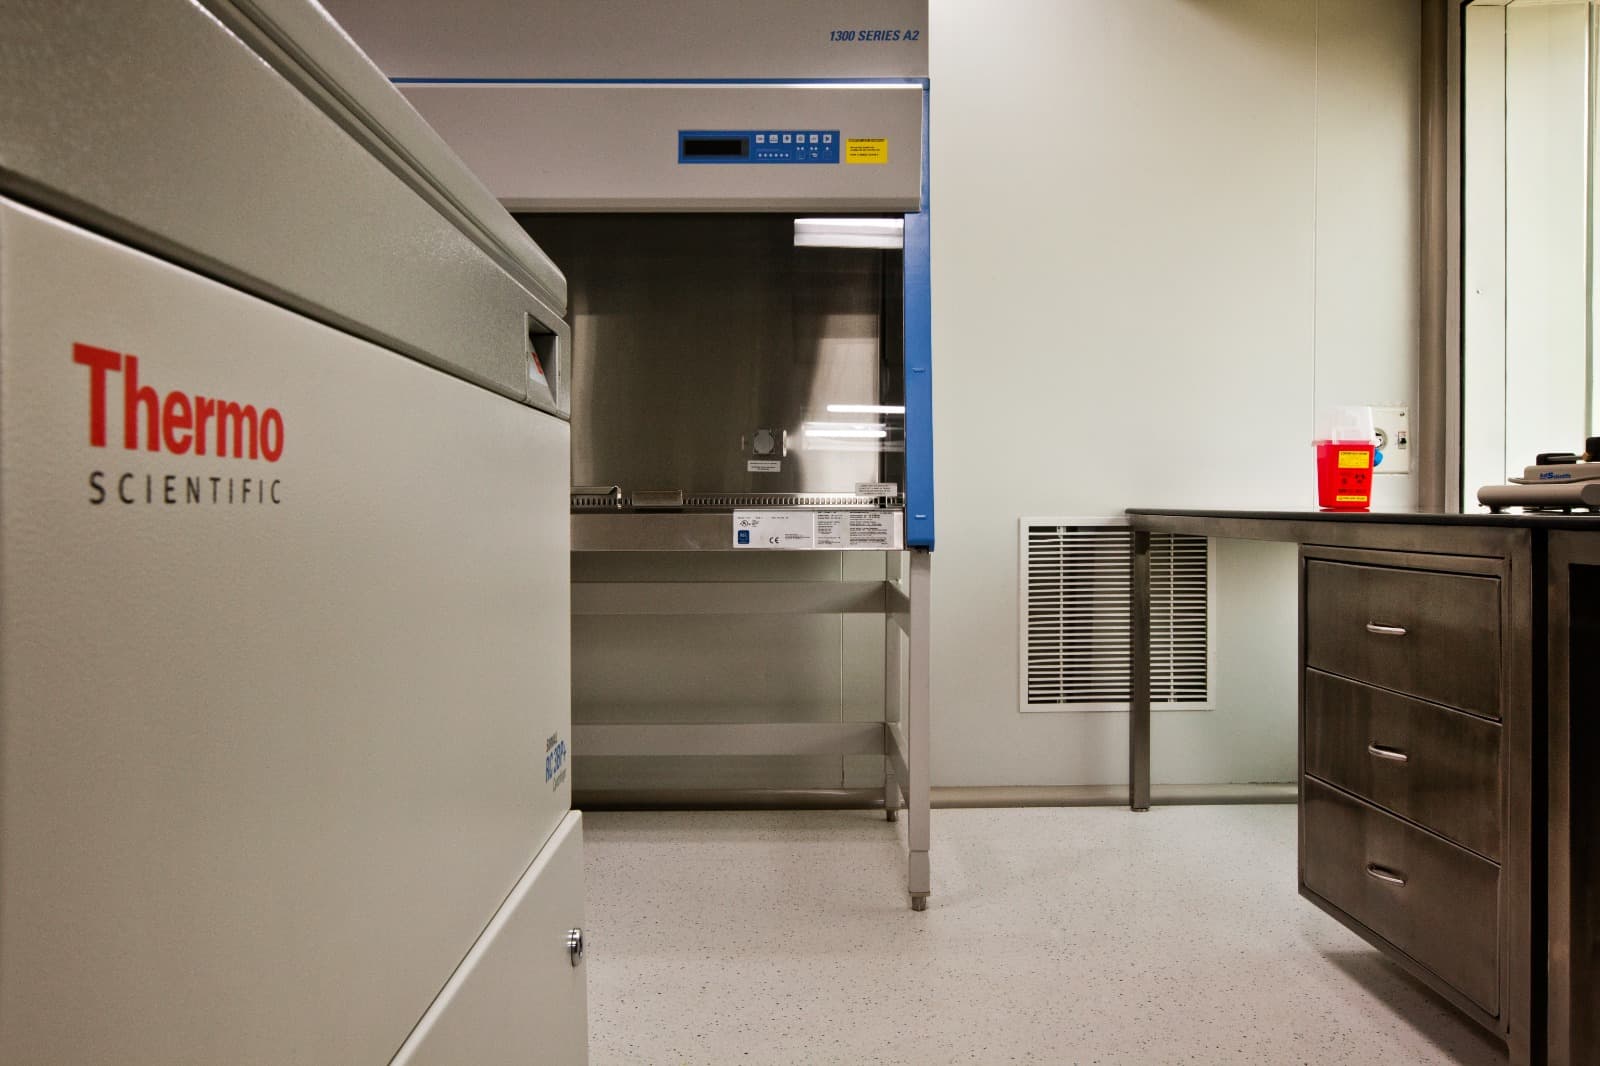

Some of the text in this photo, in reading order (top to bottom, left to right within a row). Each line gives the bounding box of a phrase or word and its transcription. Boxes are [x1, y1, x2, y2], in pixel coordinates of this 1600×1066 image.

[829, 30, 920, 41] 1300 SERIES A2
[72, 341, 285, 463] Thermo
[88, 469, 282, 505] SCIENTIFIC
